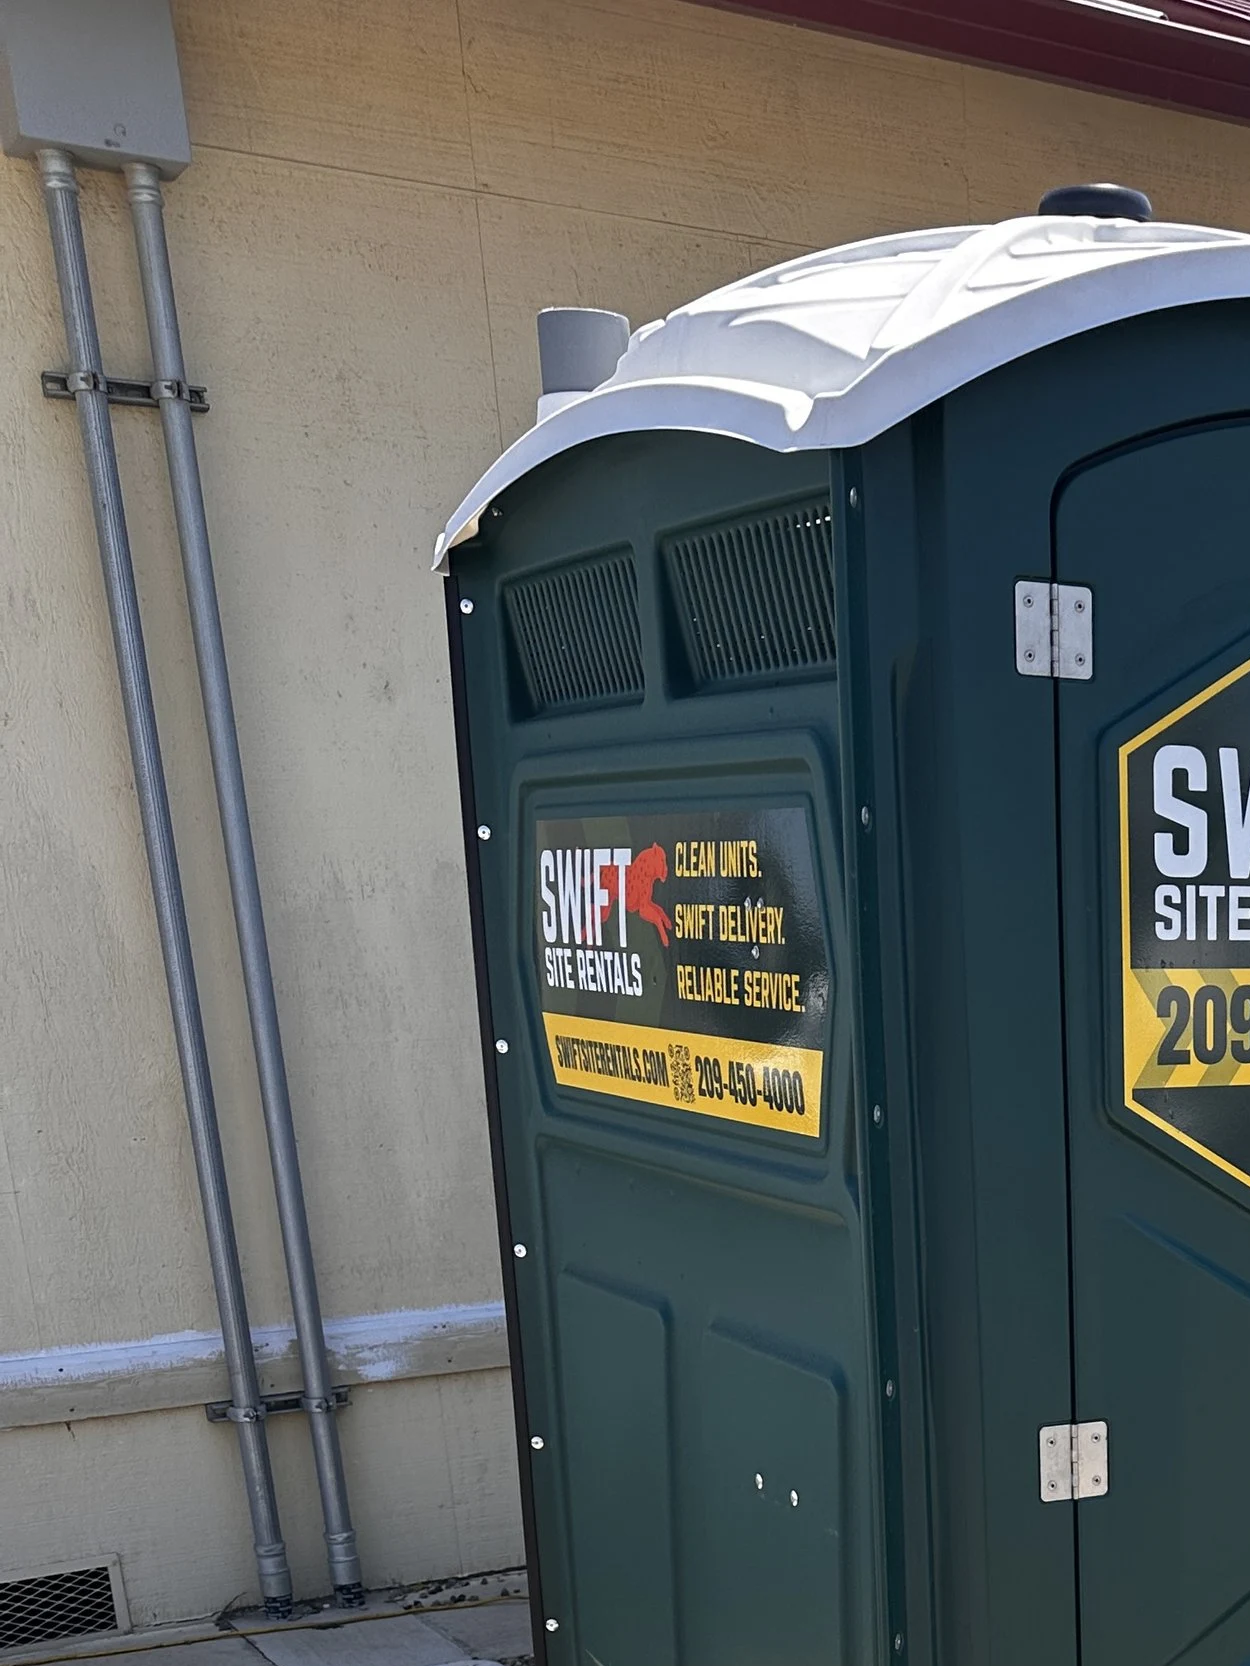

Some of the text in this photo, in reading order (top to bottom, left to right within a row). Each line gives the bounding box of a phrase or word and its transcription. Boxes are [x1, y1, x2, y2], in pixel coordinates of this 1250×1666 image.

[675, 840, 762, 878] CLEAN UNITS.
[540, 848, 632, 948] SWIFT
[675, 904, 785, 945] SWIFT DELIVERY.
[545, 947, 643, 997] SITE RENTALS
[676, 965, 806, 1013] RELIABLE SERVICE.
[555, 1035, 670, 1088] SWIFTSITERENTALS.COM
[695, 1055, 806, 1116] 209-450-4000
